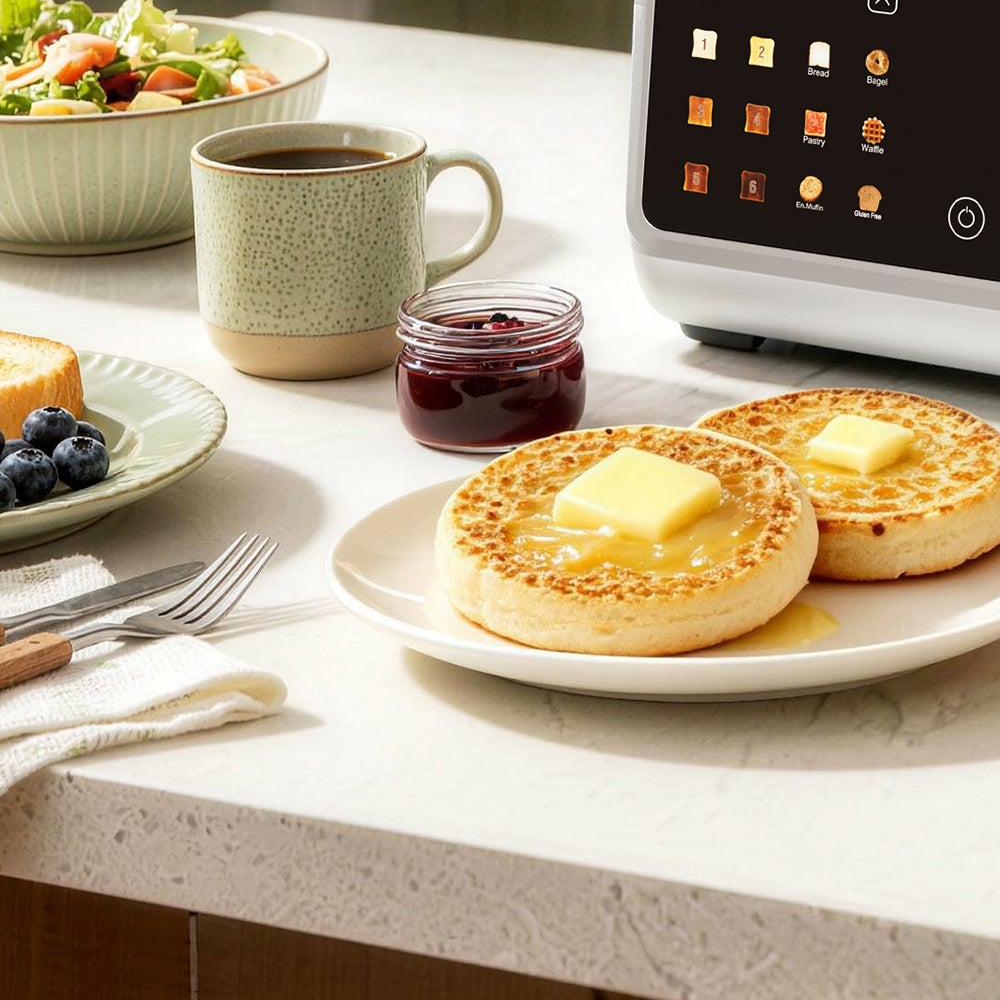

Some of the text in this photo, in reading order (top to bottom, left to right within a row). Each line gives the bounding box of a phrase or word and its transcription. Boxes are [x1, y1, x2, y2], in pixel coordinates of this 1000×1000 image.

[702, 38, 707, 51] 1
[758, 46, 766, 59] 2
[807, 67, 830, 78] Bread
[866, 76, 888, 87] Bagel
[802, 135, 826, 147] Pastry
[861, 143, 884, 154] Waffle
[749, 180, 757, 194] 6
[870, 211, 882, 221] Free
